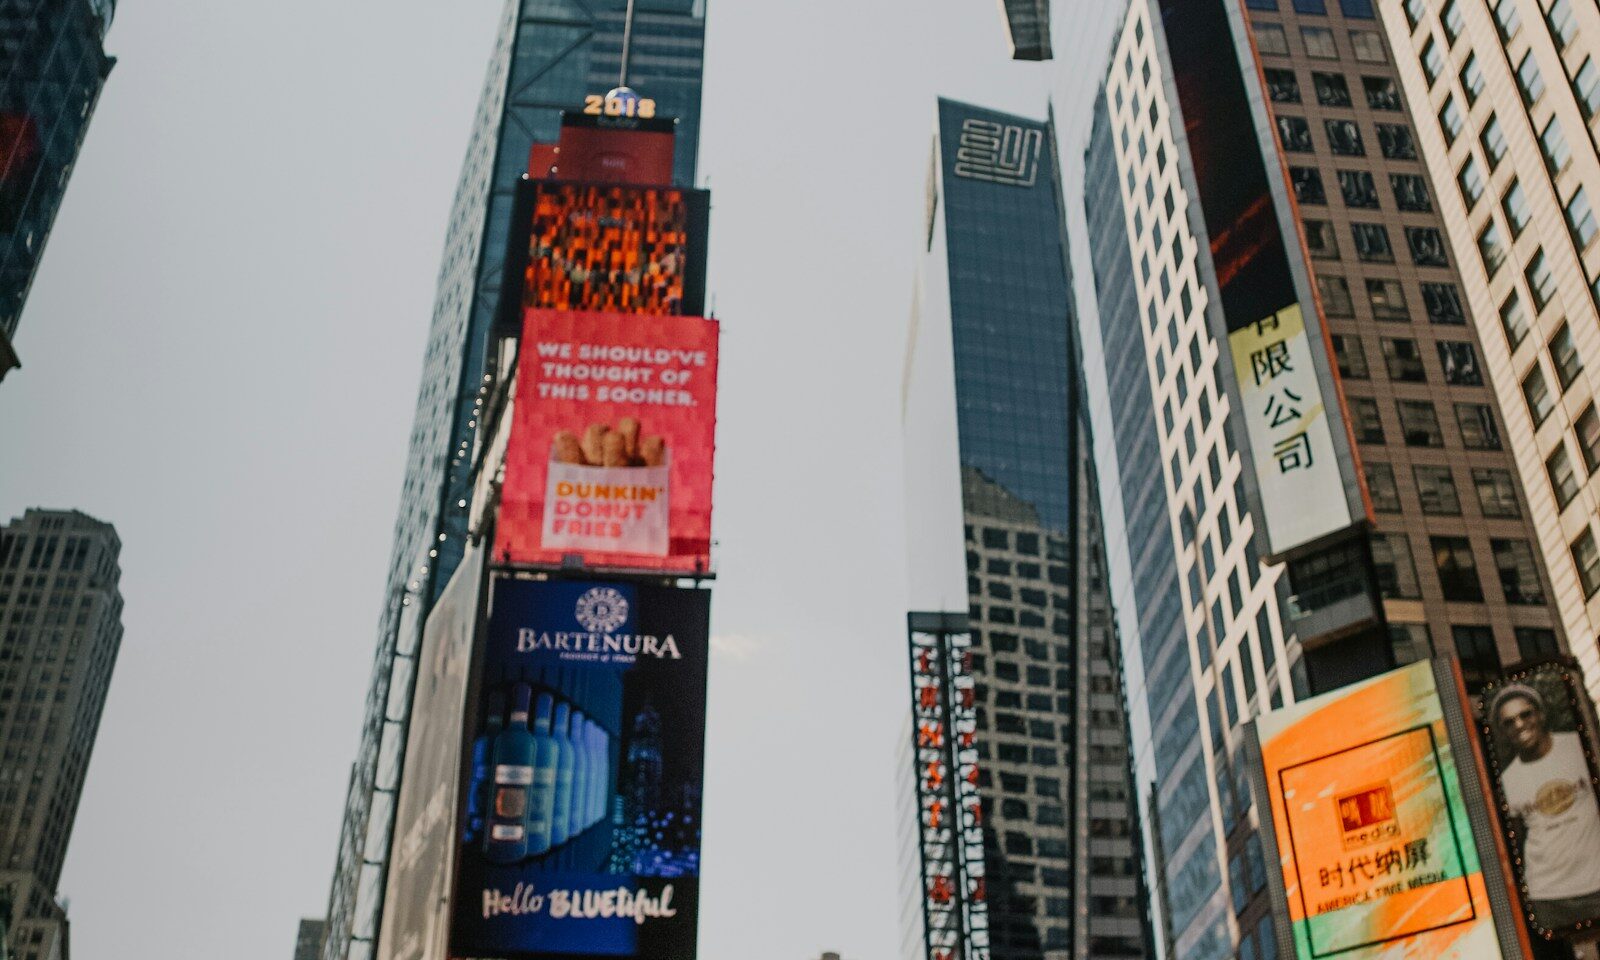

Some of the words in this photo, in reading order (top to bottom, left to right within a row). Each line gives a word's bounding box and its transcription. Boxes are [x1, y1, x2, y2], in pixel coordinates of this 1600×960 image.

[584, 94, 656, 118] 2018
[537, 342, 573, 358] WE
[578, 344, 708, 366] SHOULD'VE
[541, 362, 655, 383] THOUGHT
[660, 368, 692, 386] OF
[537, 384, 590, 400] THIS
[595, 386, 698, 408] SOONER.
[555, 480, 665, 501] DUNKIN'
[554, 500, 648, 520] DONUT
[551, 519, 624, 539] FRIES
[482, 881, 545, 920] Hello
[1316, 890, 1372, 914] AMERICA
[1375, 881, 1404, 897] TIME
